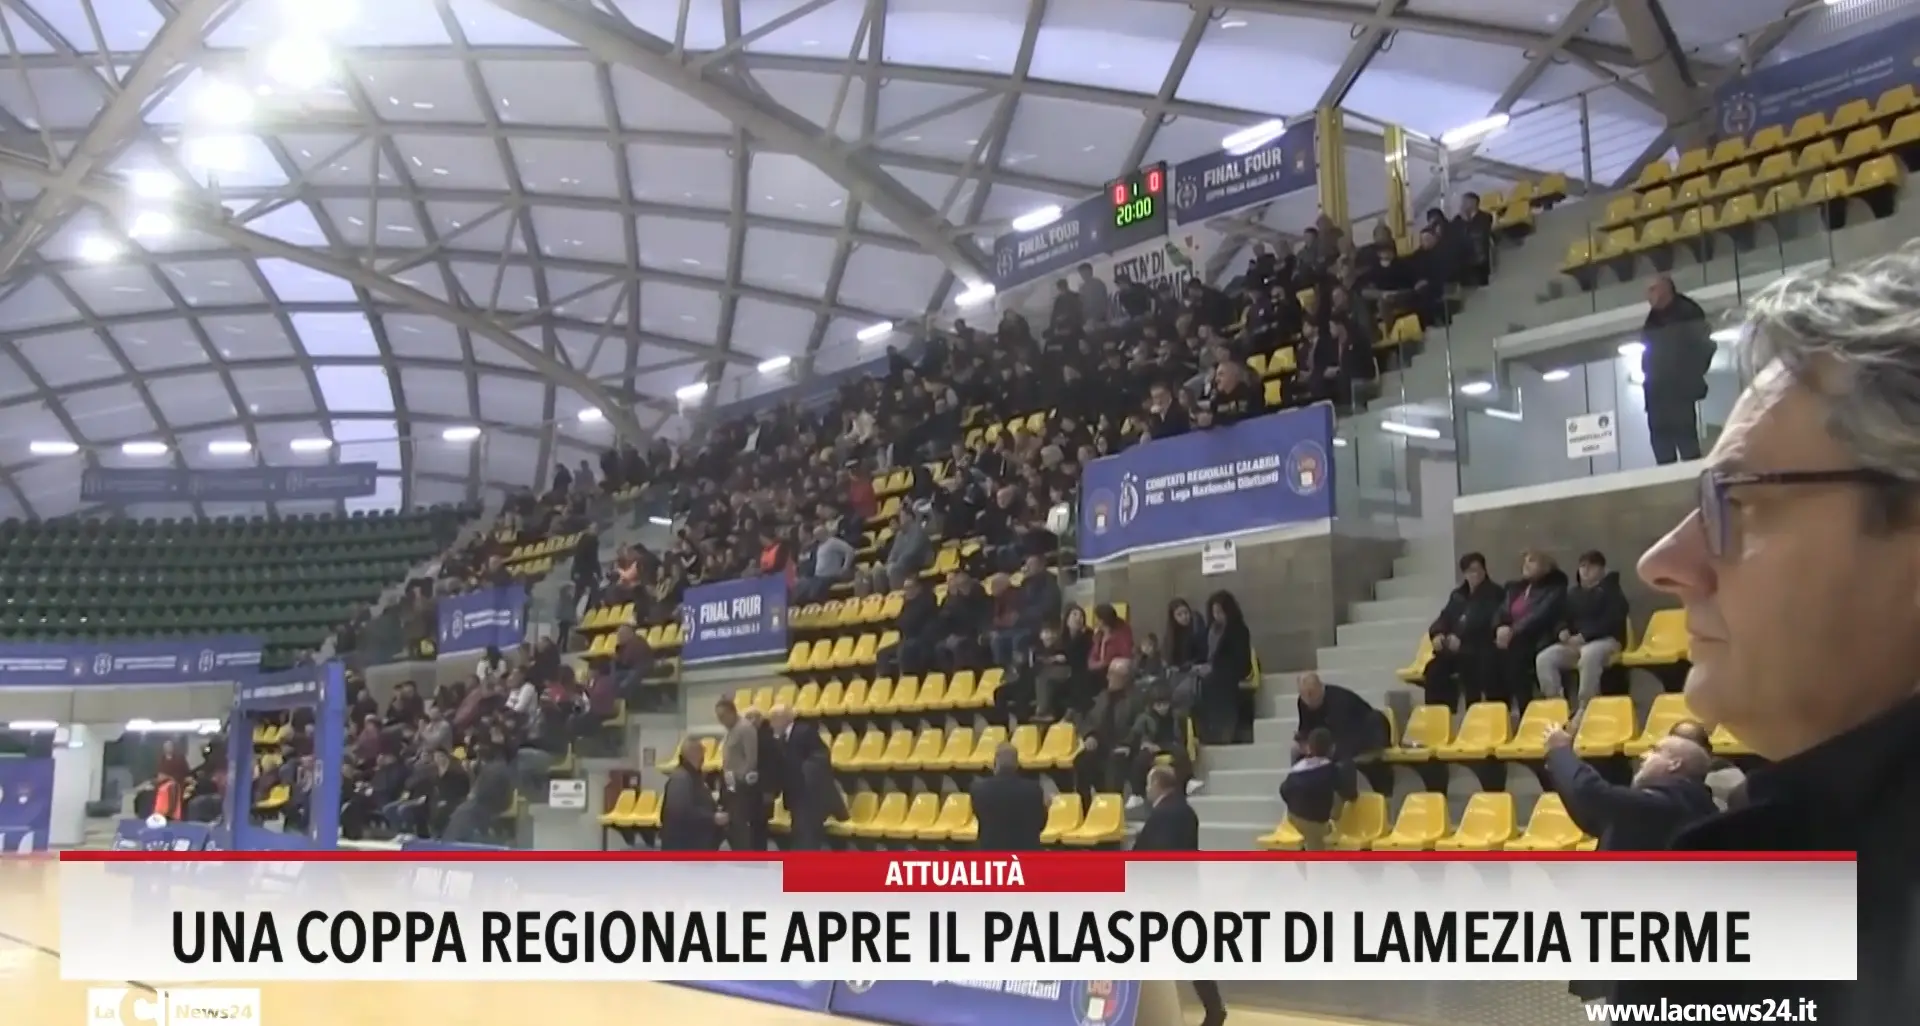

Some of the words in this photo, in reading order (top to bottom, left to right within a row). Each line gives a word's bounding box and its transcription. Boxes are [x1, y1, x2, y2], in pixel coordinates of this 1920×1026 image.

[1203, 161, 1242, 188] FINAL
[1244, 146, 1281, 174] FOUR
[1115, 184, 1125, 205] 0
[1149, 171, 1159, 192] 0
[1116, 196, 1152, 226] 20:00
[1018, 233, 1048, 258] FINAL
[1049, 221, 1079, 246] FOUR
[1145, 472, 1186, 491] COMITATO
[1187, 462, 1235, 483] REGIONALE
[1236, 454, 1280, 474] CALABRIA
[1237, 470, 1279, 490] Dilettanti
[700, 600, 730, 625] FINAL
[732, 594, 761, 620] FOUR
